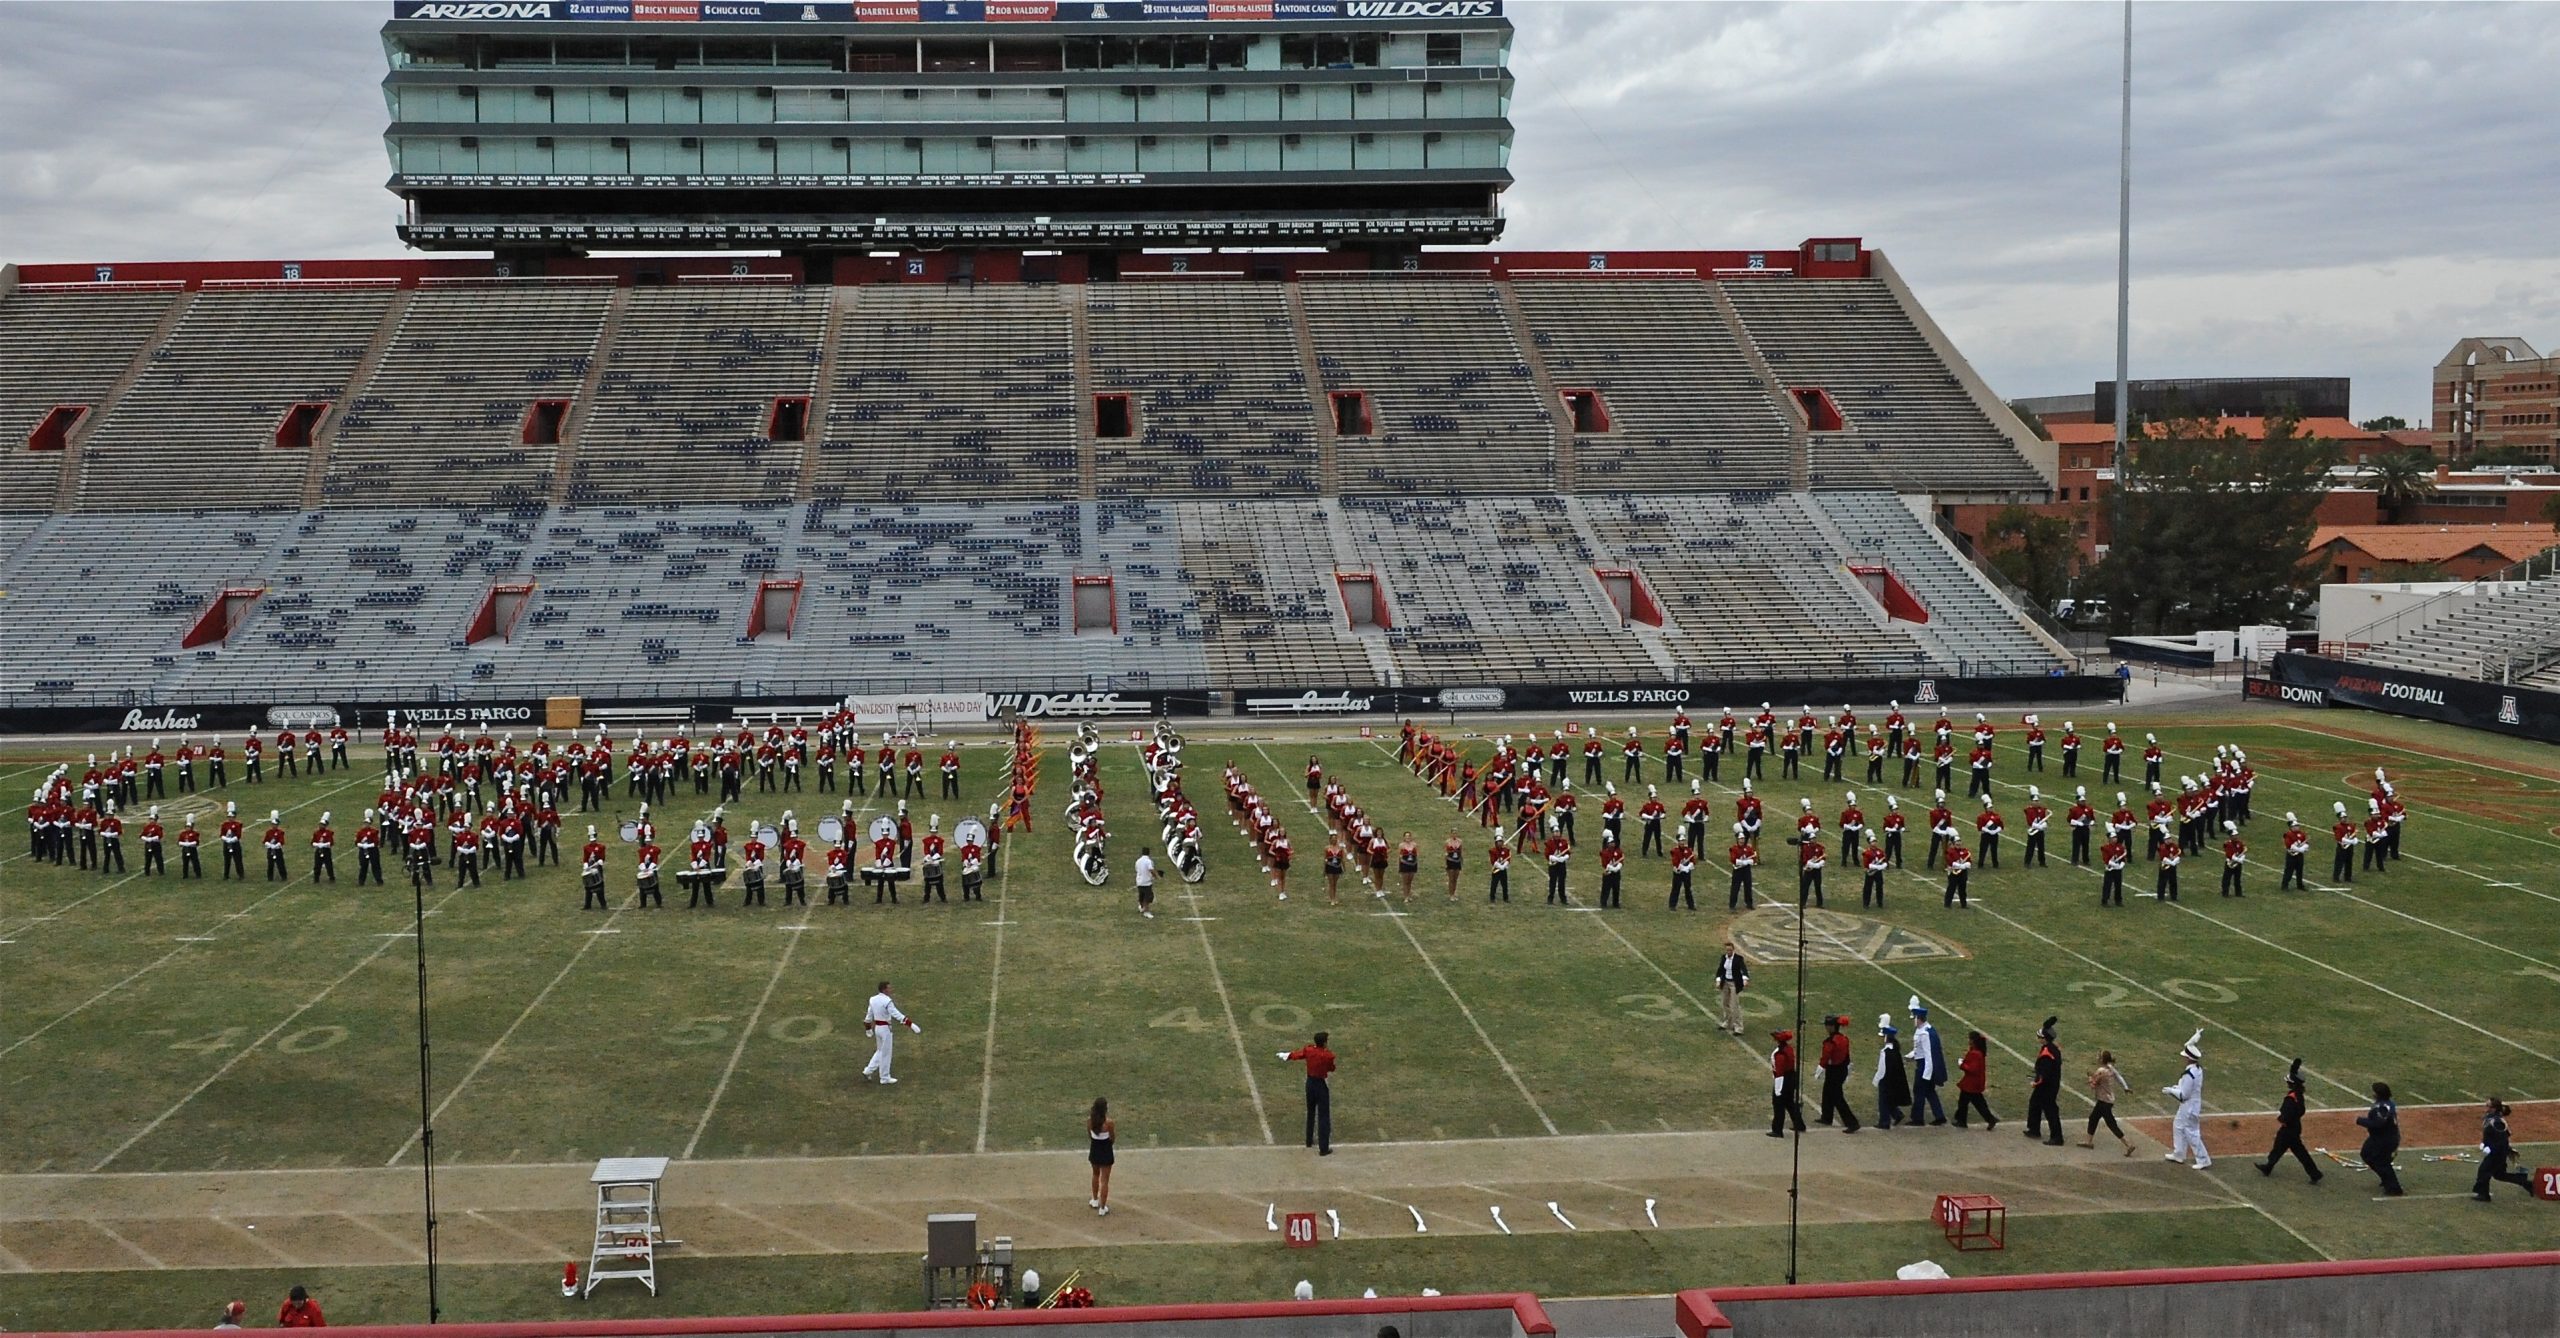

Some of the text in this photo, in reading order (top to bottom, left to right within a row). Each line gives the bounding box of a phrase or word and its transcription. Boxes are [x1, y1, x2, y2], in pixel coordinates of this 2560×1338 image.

[410, 4, 551, 19] ARIZONA
[570, 4, 629, 14] 22 ART LUPPINO
[645, 6, 668, 15] RICKY
[669, 6, 698, 15] HUNLEY
[705, 6, 762, 15] 6 CHUCK CECIL
[855, 7, 918, 16] 4 DARRYLL LEWIS
[986, 6, 1049, 15] 92 ROB WALDROP
[1143, 4, 1208, 13] 28 STEVE McLAUGHLIN
[1208, 4, 1272, 13] 11 CHRIS McALISTER
[1274, 4, 1336, 13] 5 ANTOINE CASON
[1347, 1, 1494, 16] WILDCATS
[732, 265, 748, 275] 20
[910, 264, 923, 274] 21
[1173, 262, 1187, 272] 22
[1404, 260, 1418, 270] 23
[1590, 260, 1605, 270] 24
[1749, 260, 1764, 269] 25
[97, 272, 111, 282] 17
[285, 269, 299, 280] 18
[497, 267, 510, 277] 19
[1568, 690, 1690, 703] WELLS FARGO
[1915, 680, 1938, 703] A
[2382, 682, 2445, 705] FOOTBALL
[944, 701, 965, 713] BAND
[967, 701, 982, 712] DAY
[2498, 696, 2519, 724] A
[120, 708, 201, 730] Bashas'
[404, 707, 530, 721] WELLS FARGO
[2068, 977, 2240, 1008] 20
[1615, 993, 1784, 1022] 30
[1149, 1004, 1313, 1032] 40
[662, 1014, 834, 1046] 50
[169, 1026, 350, 1055] 40
[1290, 1219, 1312, 1242] 40
[626, 1240, 644, 1258] 50
